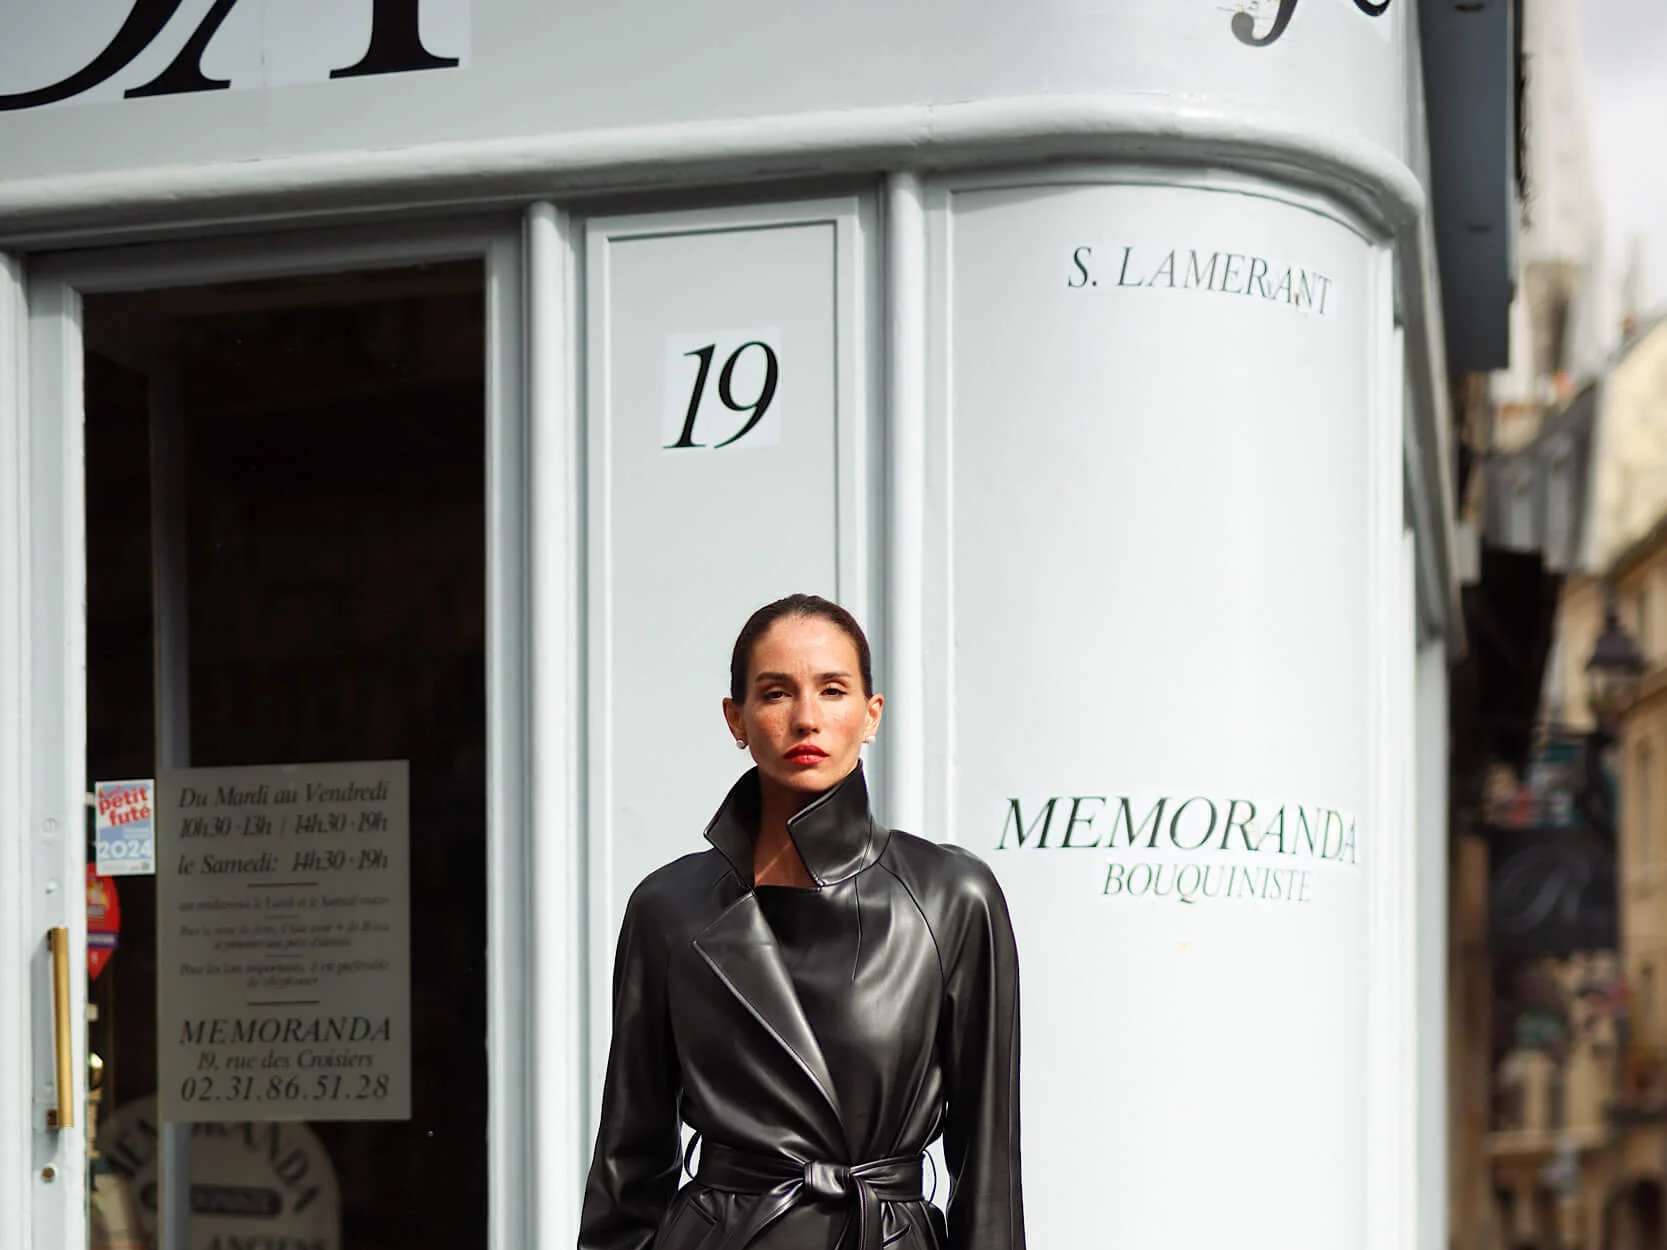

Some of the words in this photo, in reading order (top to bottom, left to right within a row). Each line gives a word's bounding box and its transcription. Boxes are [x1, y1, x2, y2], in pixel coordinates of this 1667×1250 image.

[1068, 246, 1098, 288] S.
[1116, 246, 1333, 316] LAMERANT
[662, 340, 779, 449] 19
[98, 786, 148, 816] petit
[178, 786, 207, 809] Du
[214, 783, 270, 807] Mardi
[273, 788, 298, 806] au
[305, 780, 391, 804] Vendredi
[994, 796, 1358, 865] MEMORANDA
[99, 840, 153, 859] 2024
[177, 854, 196, 876] le
[1102, 862, 1311, 904] BOUQUINISTE
[178, 1016, 392, 1045] MEMORANDA
[225, 1055, 258, 1070] rue
[261, 1048, 291, 1069] des
[296, 1048, 375, 1069] Croisiers
[180, 1073, 390, 1102] 02.31.86.51.28
